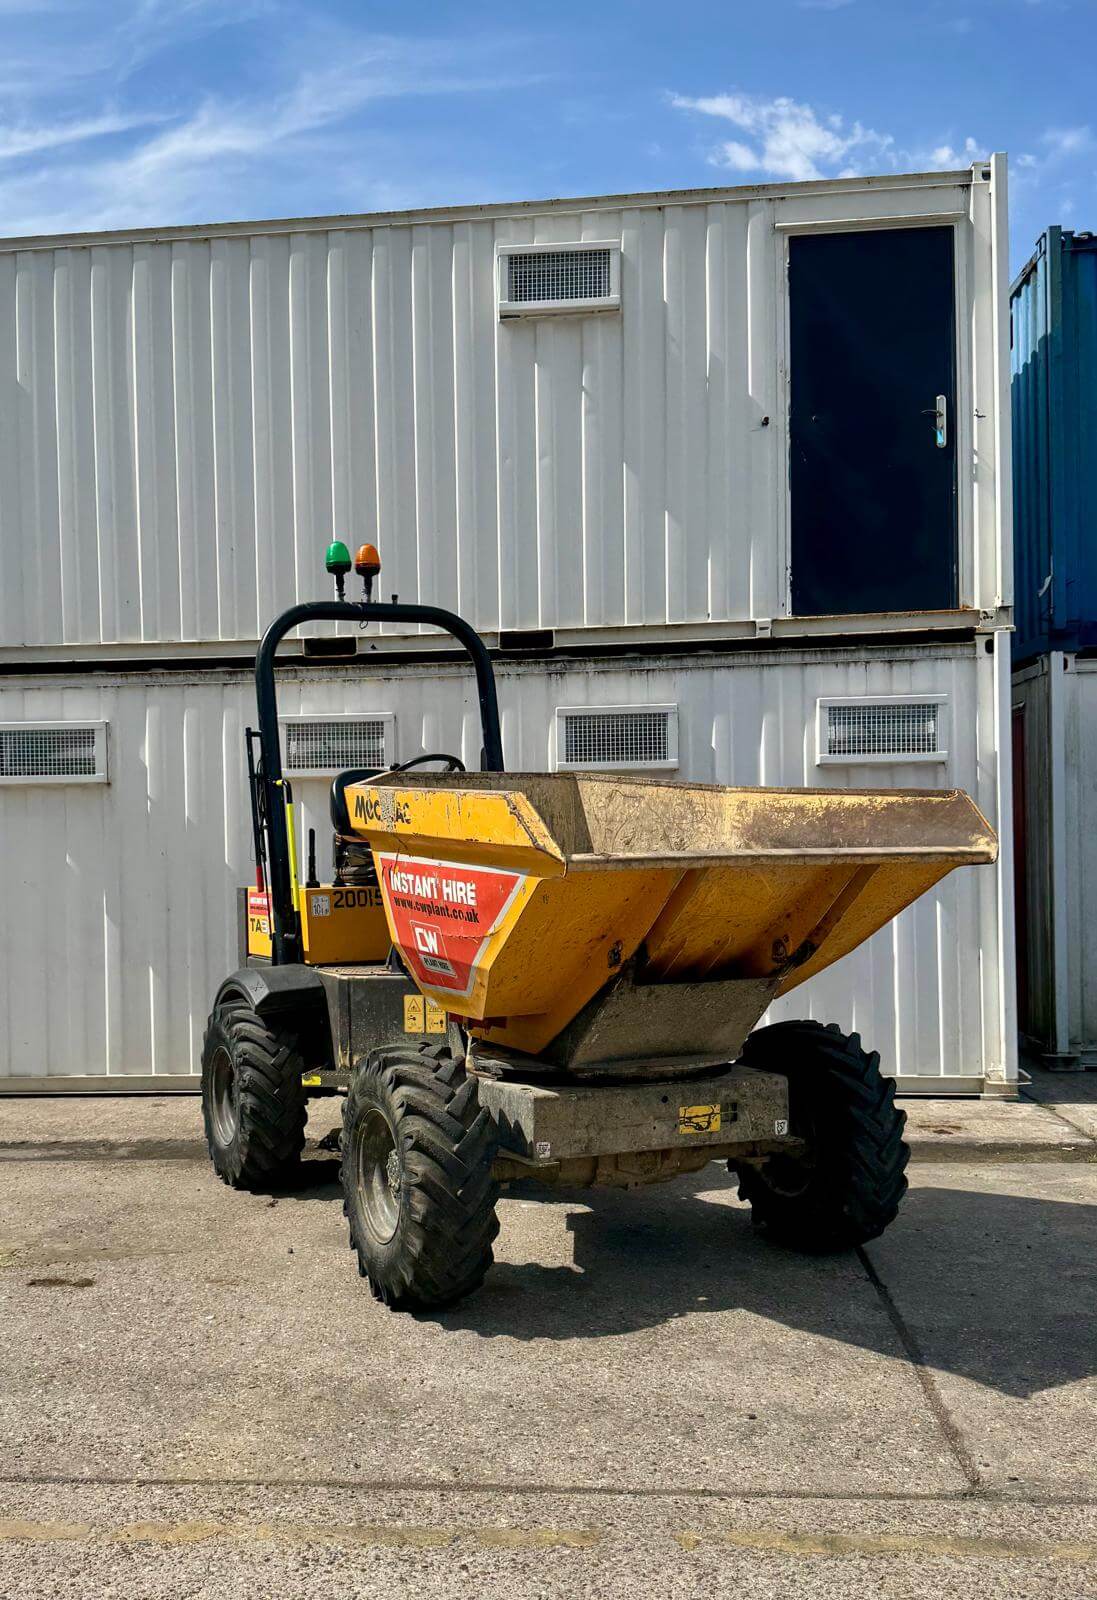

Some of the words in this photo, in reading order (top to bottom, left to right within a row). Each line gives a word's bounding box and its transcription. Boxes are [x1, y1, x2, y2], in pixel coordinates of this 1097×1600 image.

[390, 870, 438, 899] INSTANT
[442, 879, 477, 906] HIRE
[393, 896, 480, 924] www.cwplant.co.uk
[414, 927, 438, 955] CW
